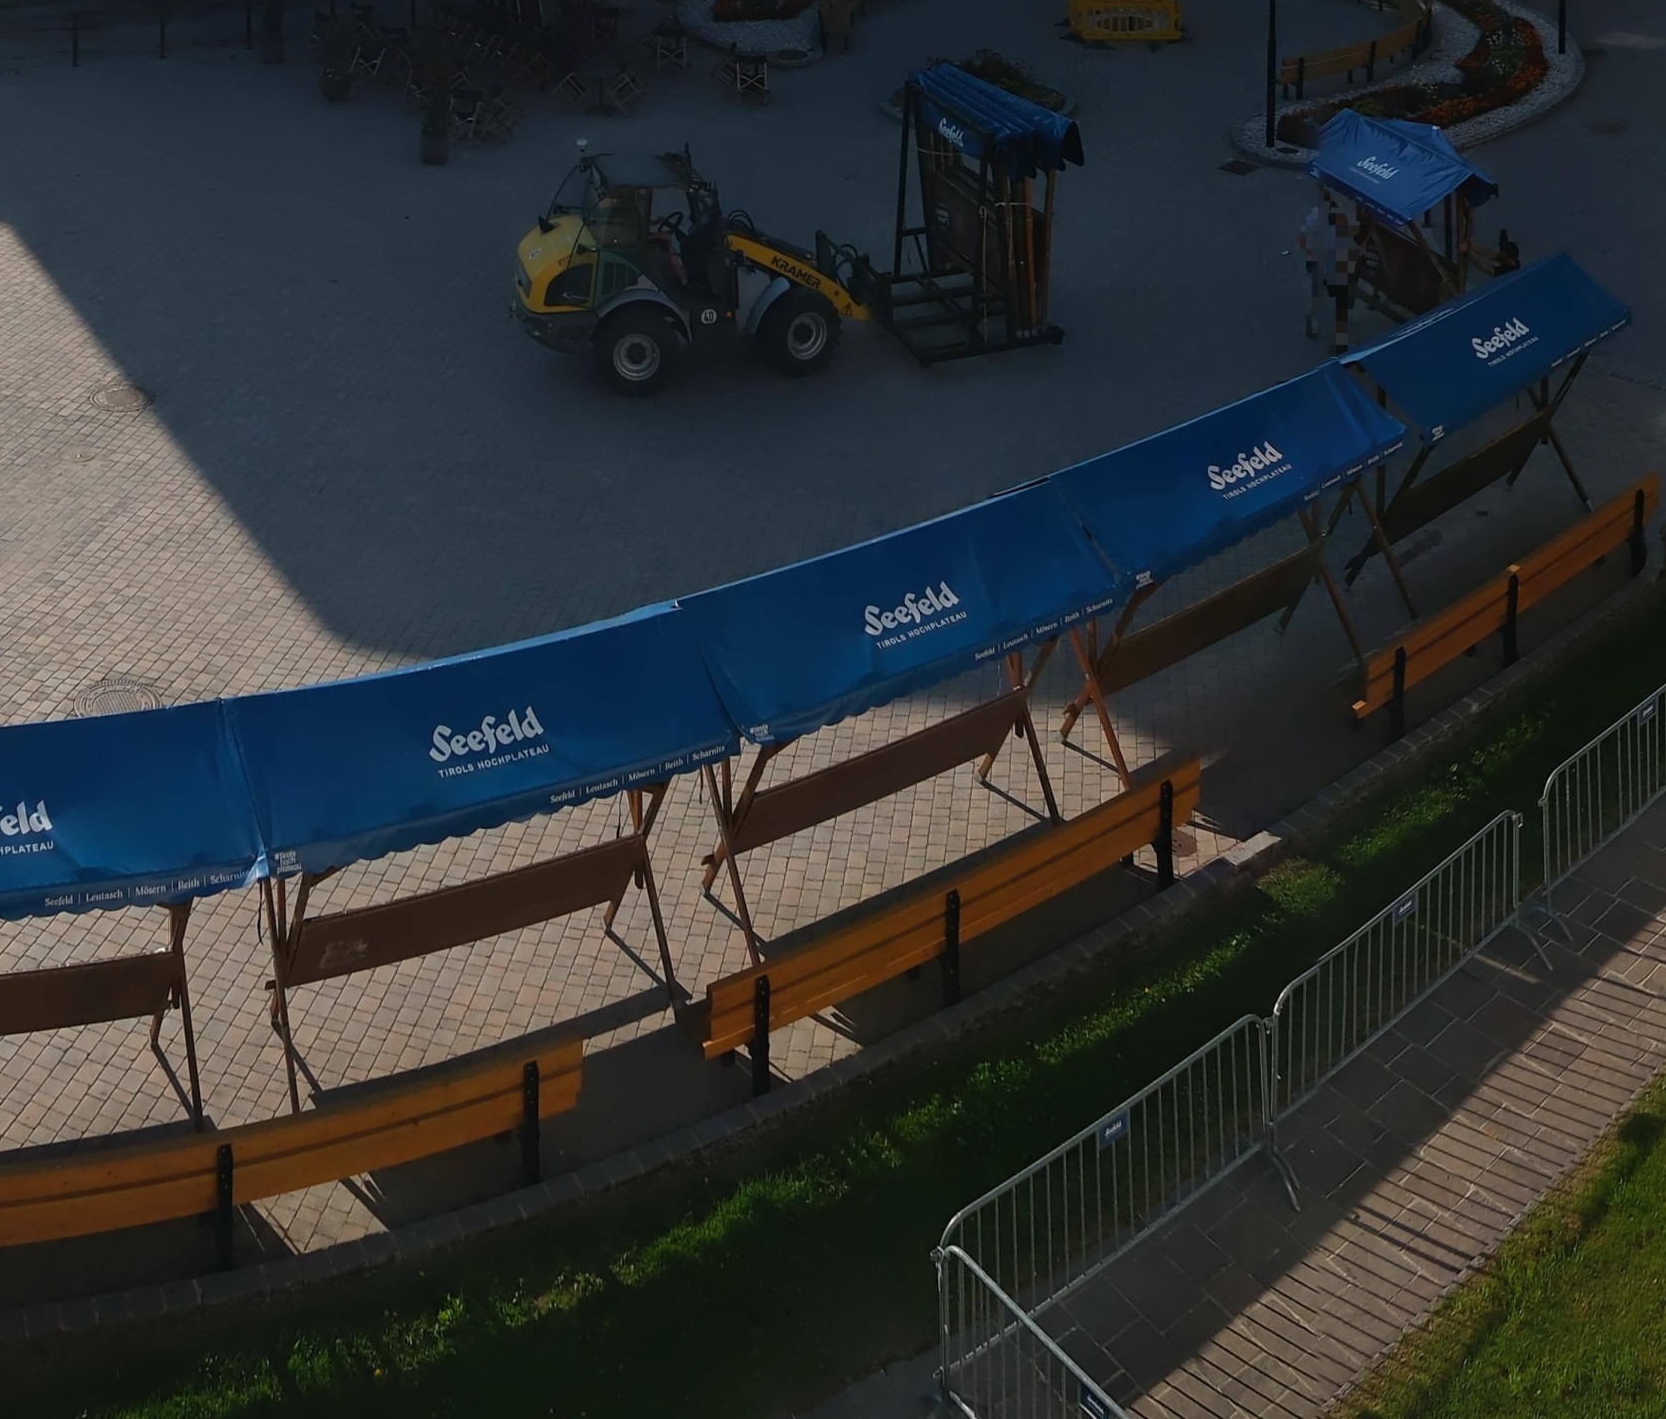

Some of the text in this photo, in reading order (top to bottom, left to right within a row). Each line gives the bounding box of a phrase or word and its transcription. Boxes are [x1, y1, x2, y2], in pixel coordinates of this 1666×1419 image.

[1357, 156, 1400, 180] Seefeld
[771, 255, 822, 290] KRAMER
[1472, 317, 1530, 360] Seefeld
[1207, 441, 1283, 490] Seefeld
[864, 580, 959, 636] Seefeld
[876, 611, 968, 650] TIROLS HOCHPLATEAU
[429, 705, 544, 762] Seefeld
[438, 743, 550, 779] TIROLS HOCHPLATEAU
[550, 790, 575, 804] Seefeld
[585, 779, 618, 794] Leutasch
[665, 757, 684, 770] Reith
[45, 895, 74, 907] Seefeld
[86, 889, 124, 902] Leutasch
[136, 884, 167, 896] Mösern
[178, 878, 200, 890] Reith
